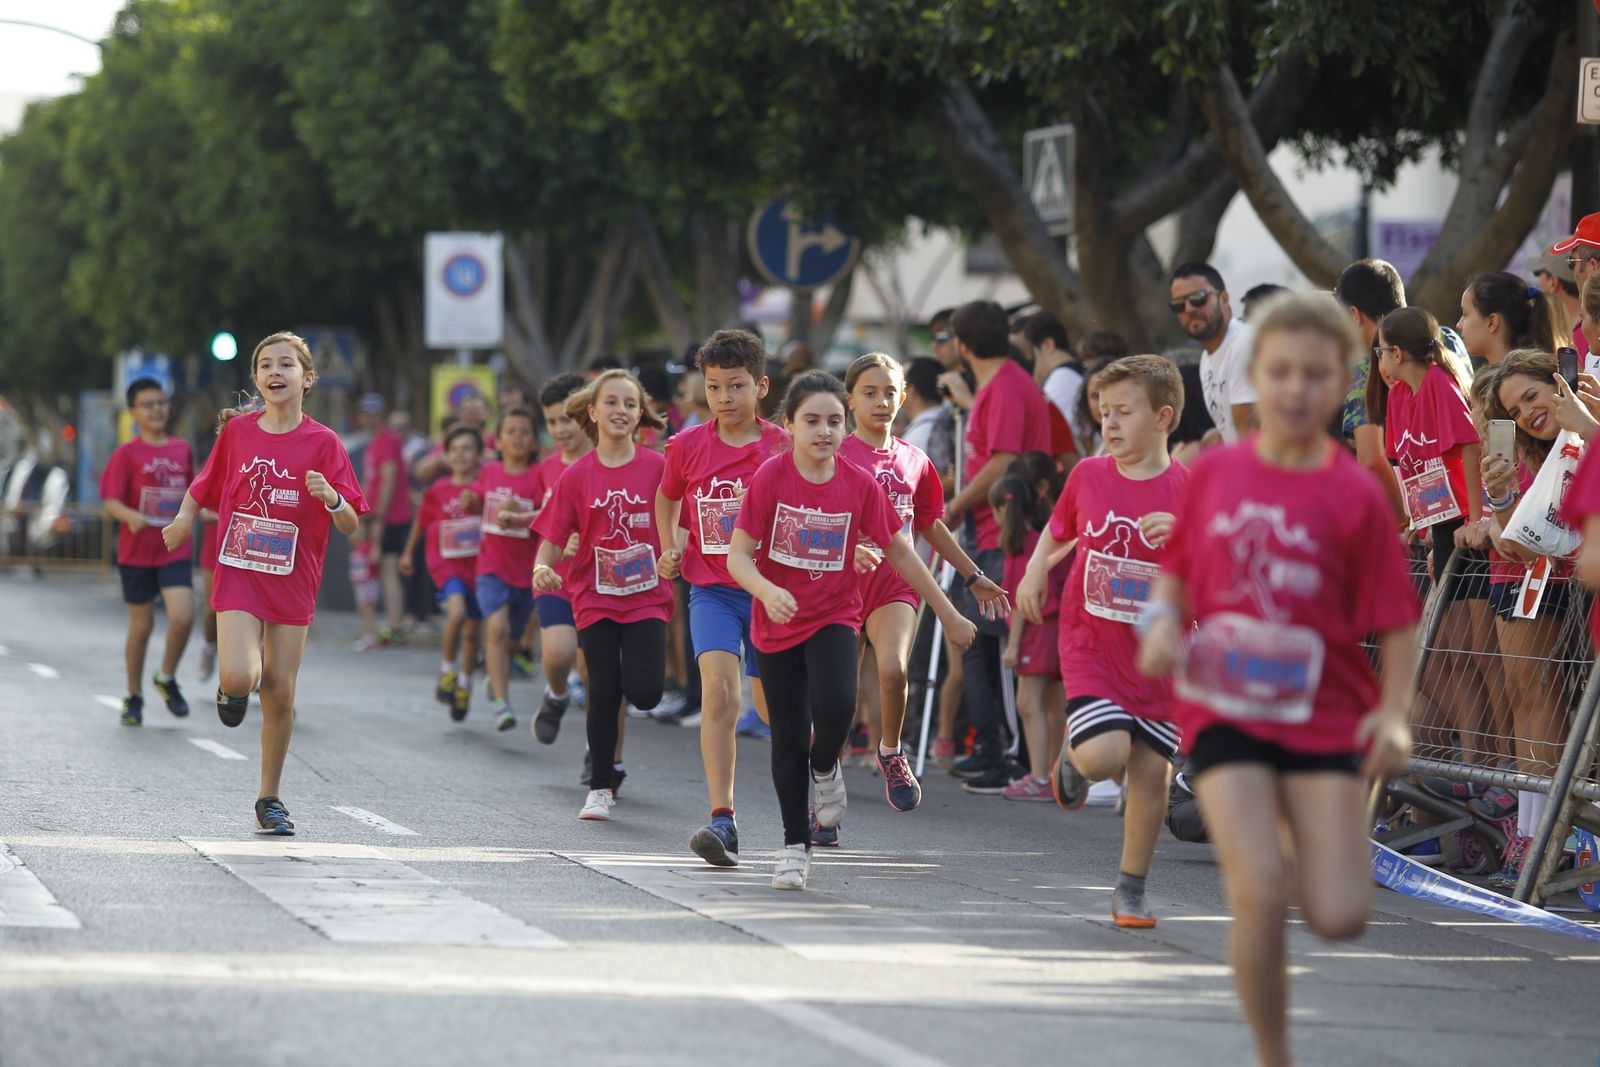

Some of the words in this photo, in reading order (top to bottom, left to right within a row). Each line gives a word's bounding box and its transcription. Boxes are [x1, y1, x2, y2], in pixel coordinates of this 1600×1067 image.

[267, 488, 276, 504] 4
[246, 533, 292, 554] 1759
[797, 529, 843, 549] 1936
[1111, 578, 1151, 600] 182
